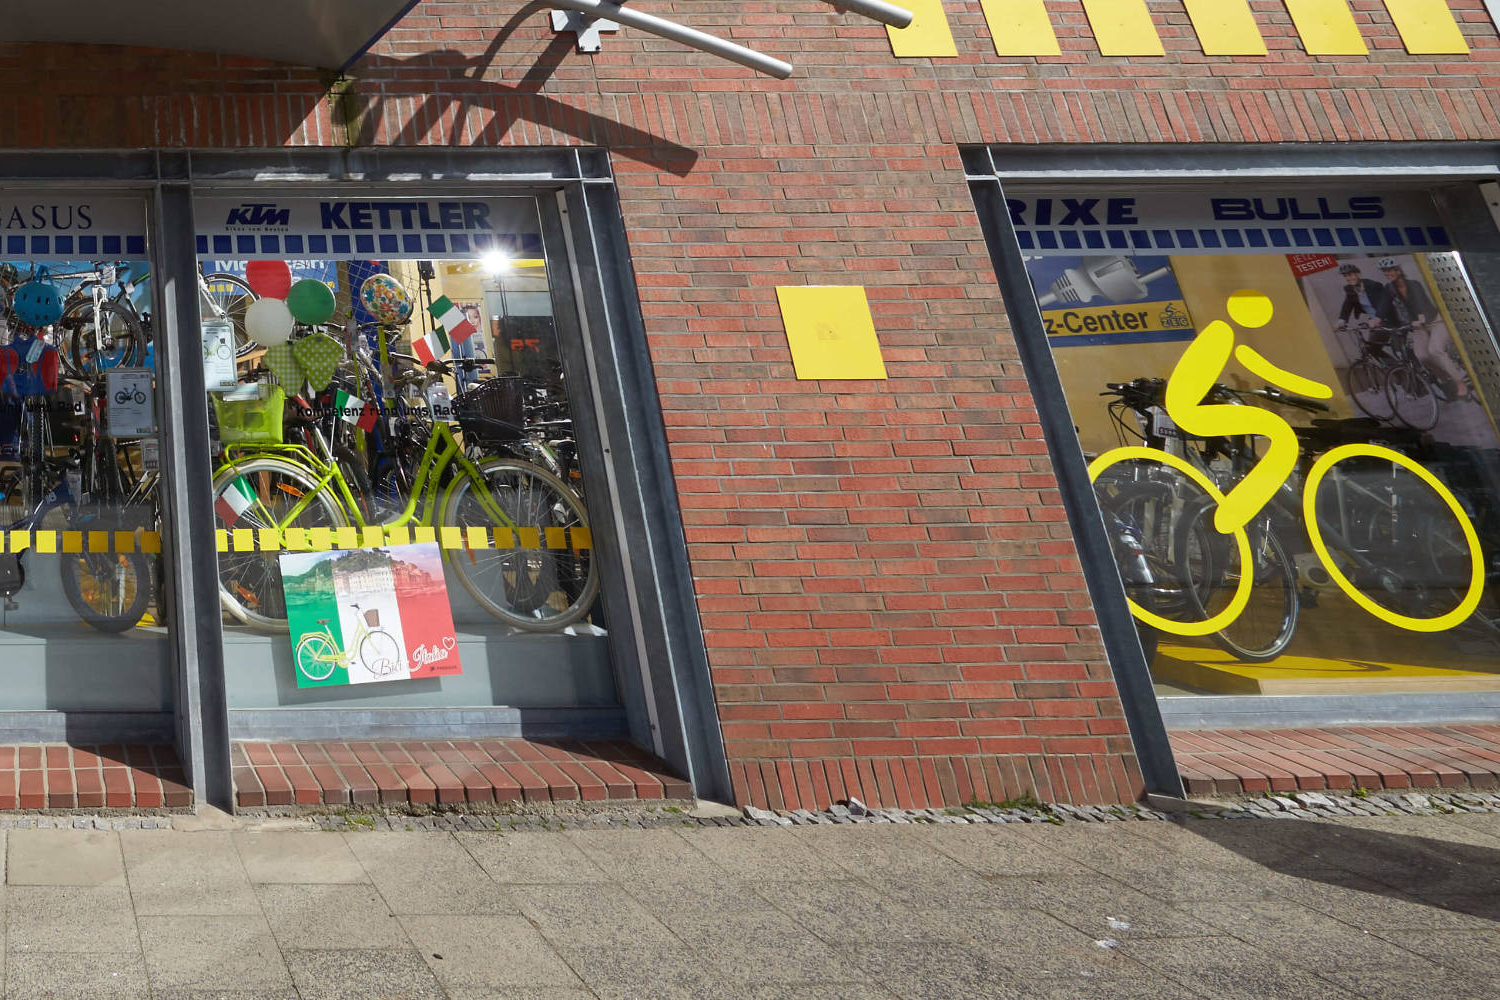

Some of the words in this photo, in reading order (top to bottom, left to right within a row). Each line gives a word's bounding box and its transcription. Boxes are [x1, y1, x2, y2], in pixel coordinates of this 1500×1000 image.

[225, 204, 290, 225] KTM
[320, 202, 493, 230] KETTLER
[1210, 197, 1385, 221] BULLS
[1296, 257, 1333, 273] TESTEN!
